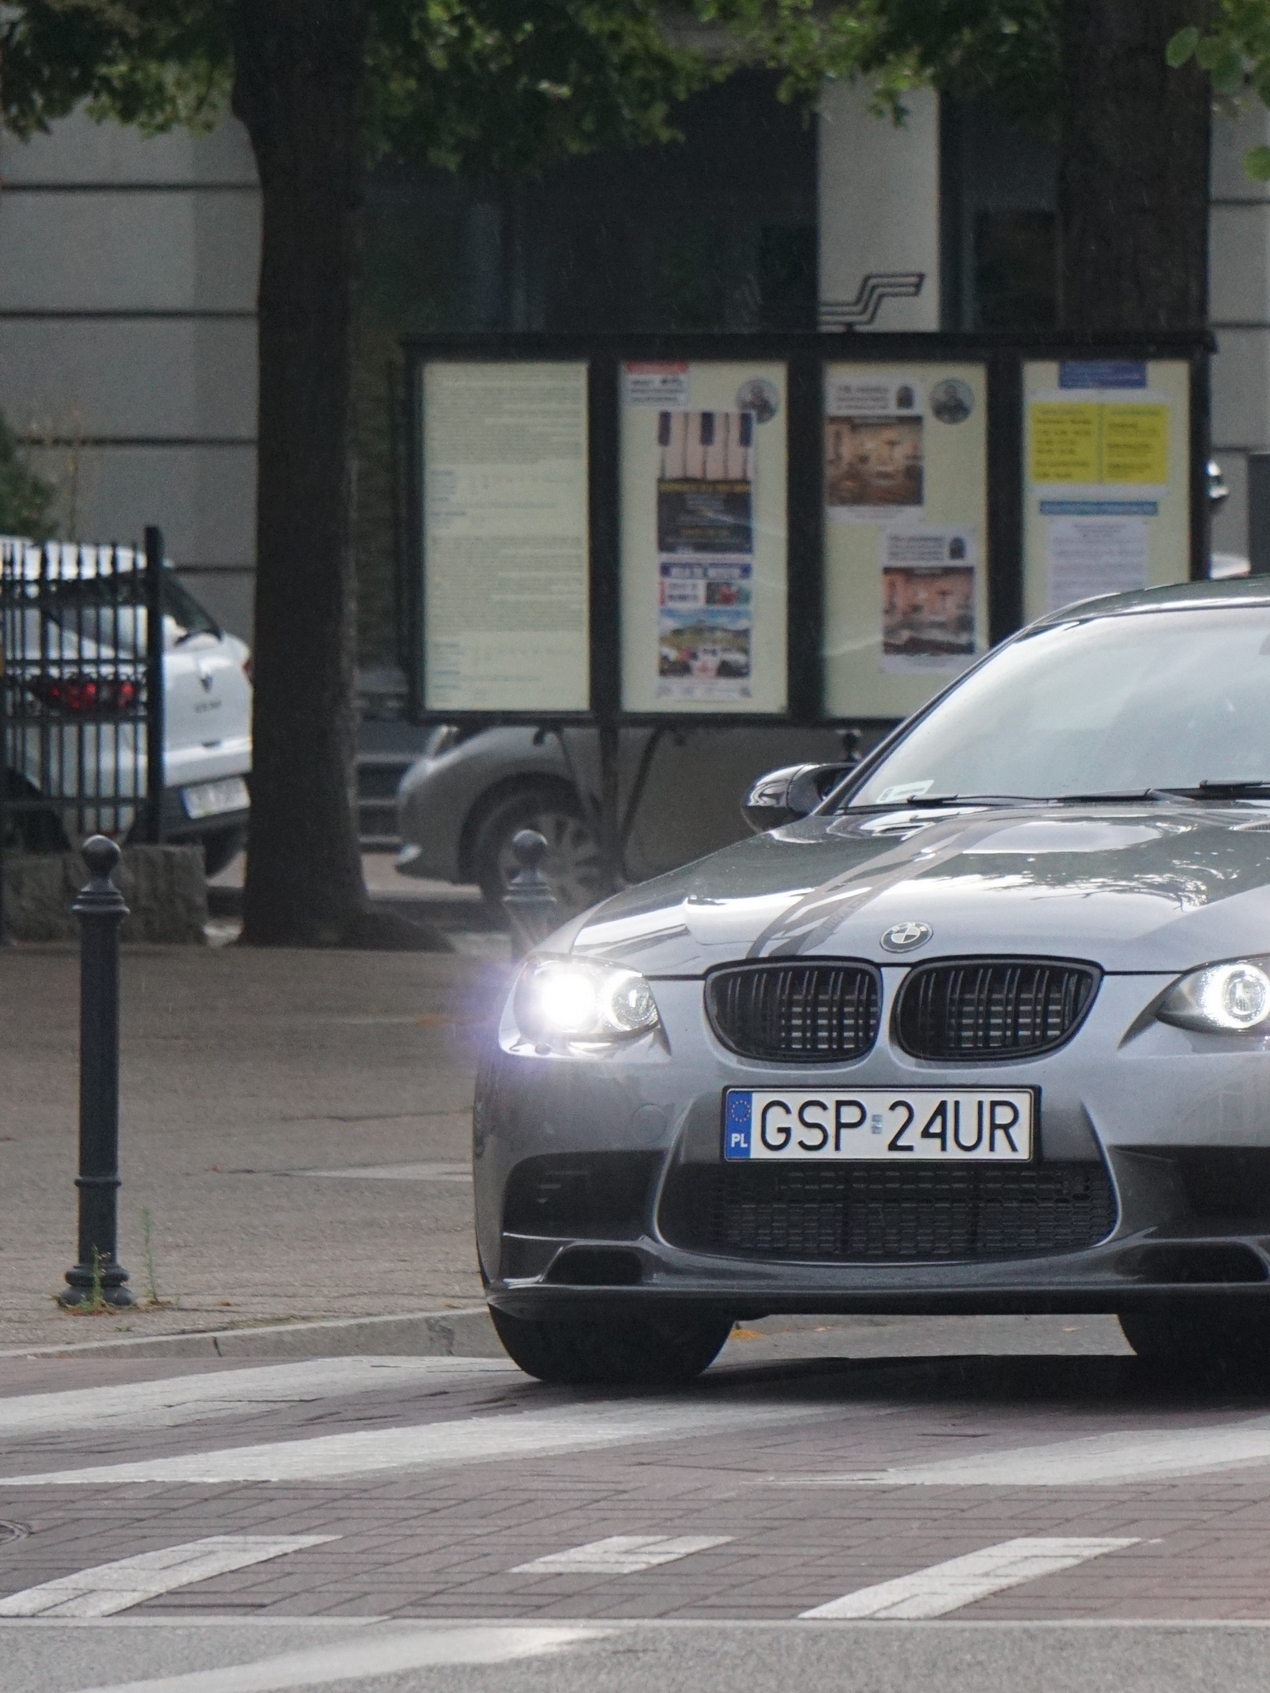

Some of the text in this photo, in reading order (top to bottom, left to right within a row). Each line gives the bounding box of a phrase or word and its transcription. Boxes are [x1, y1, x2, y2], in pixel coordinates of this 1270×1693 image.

[731, 1133, 748, 1148] PL
[760, 1099, 1019, 1152] GSP 24UR
